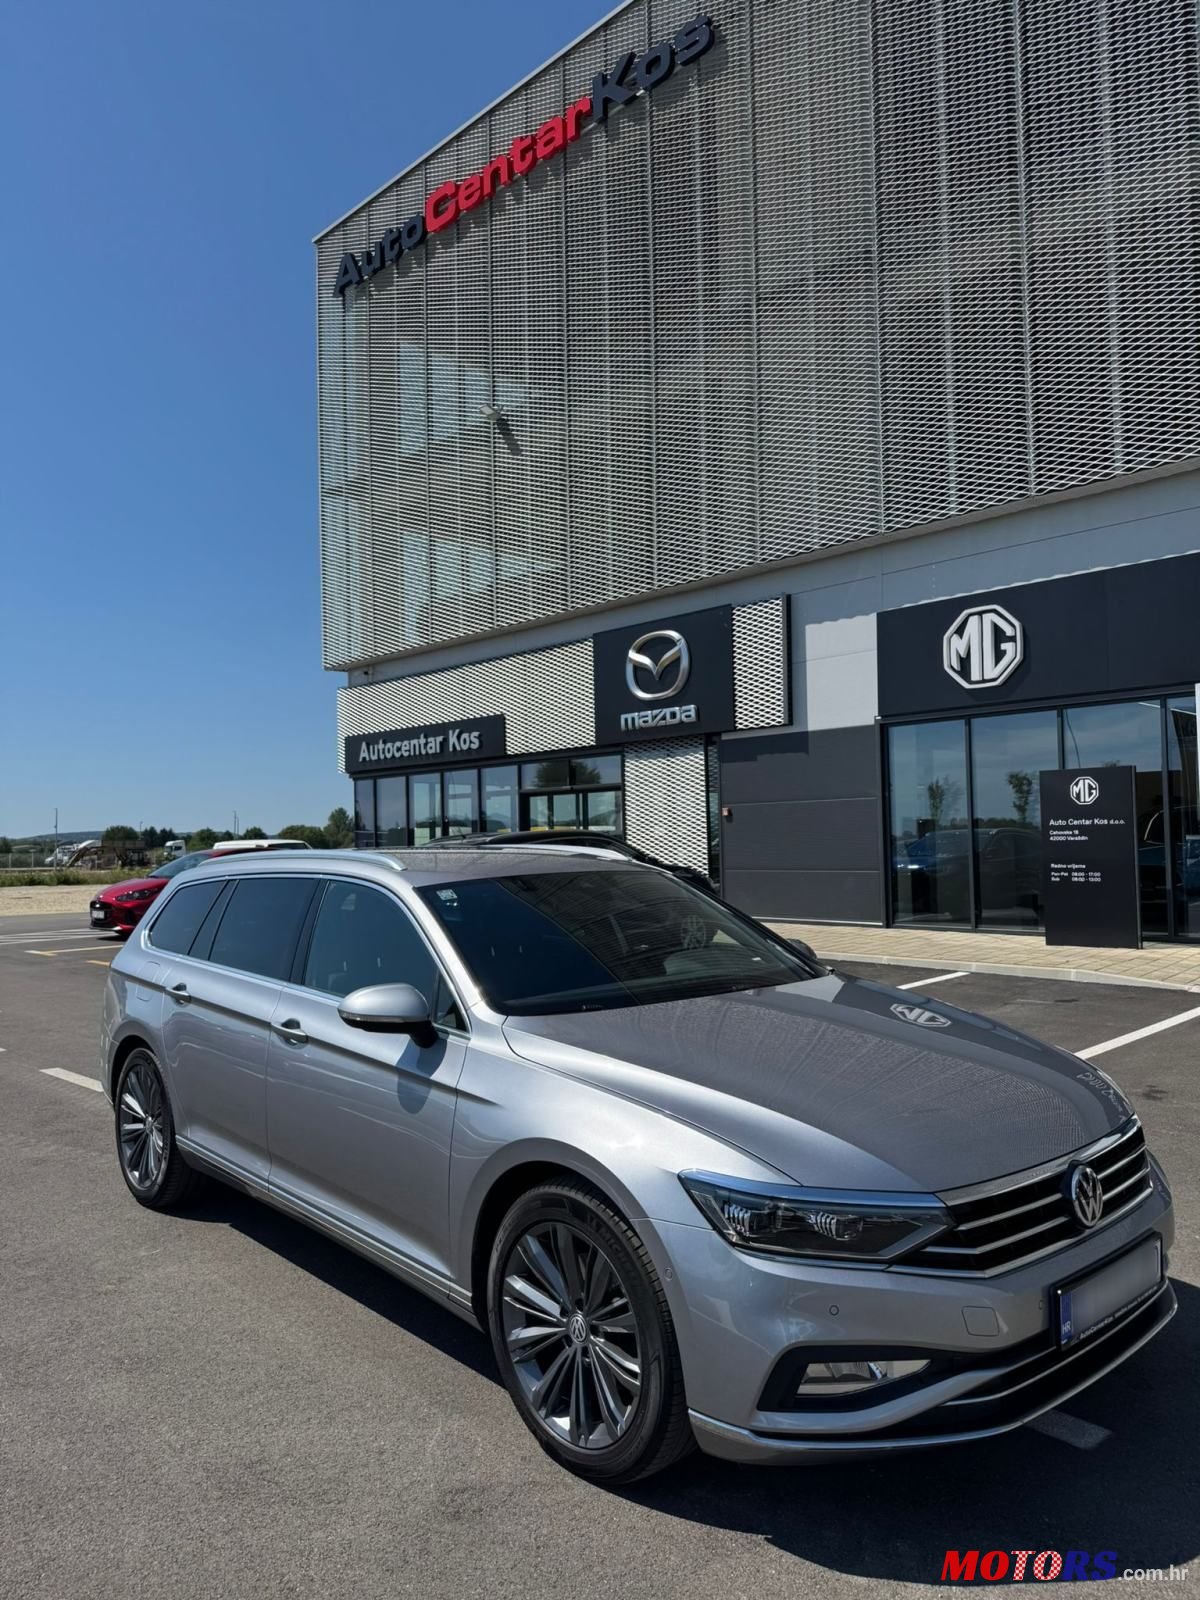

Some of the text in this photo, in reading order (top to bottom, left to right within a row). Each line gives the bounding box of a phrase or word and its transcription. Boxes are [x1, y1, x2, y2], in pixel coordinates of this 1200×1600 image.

[948, 609, 1018, 684] MG
[358, 728, 482, 763] Autocentar Kos
[1072, 778, 1097, 803] MG
[1068, 818, 1093, 826] Centar
[1062, 1320, 1071, 1335] HR
